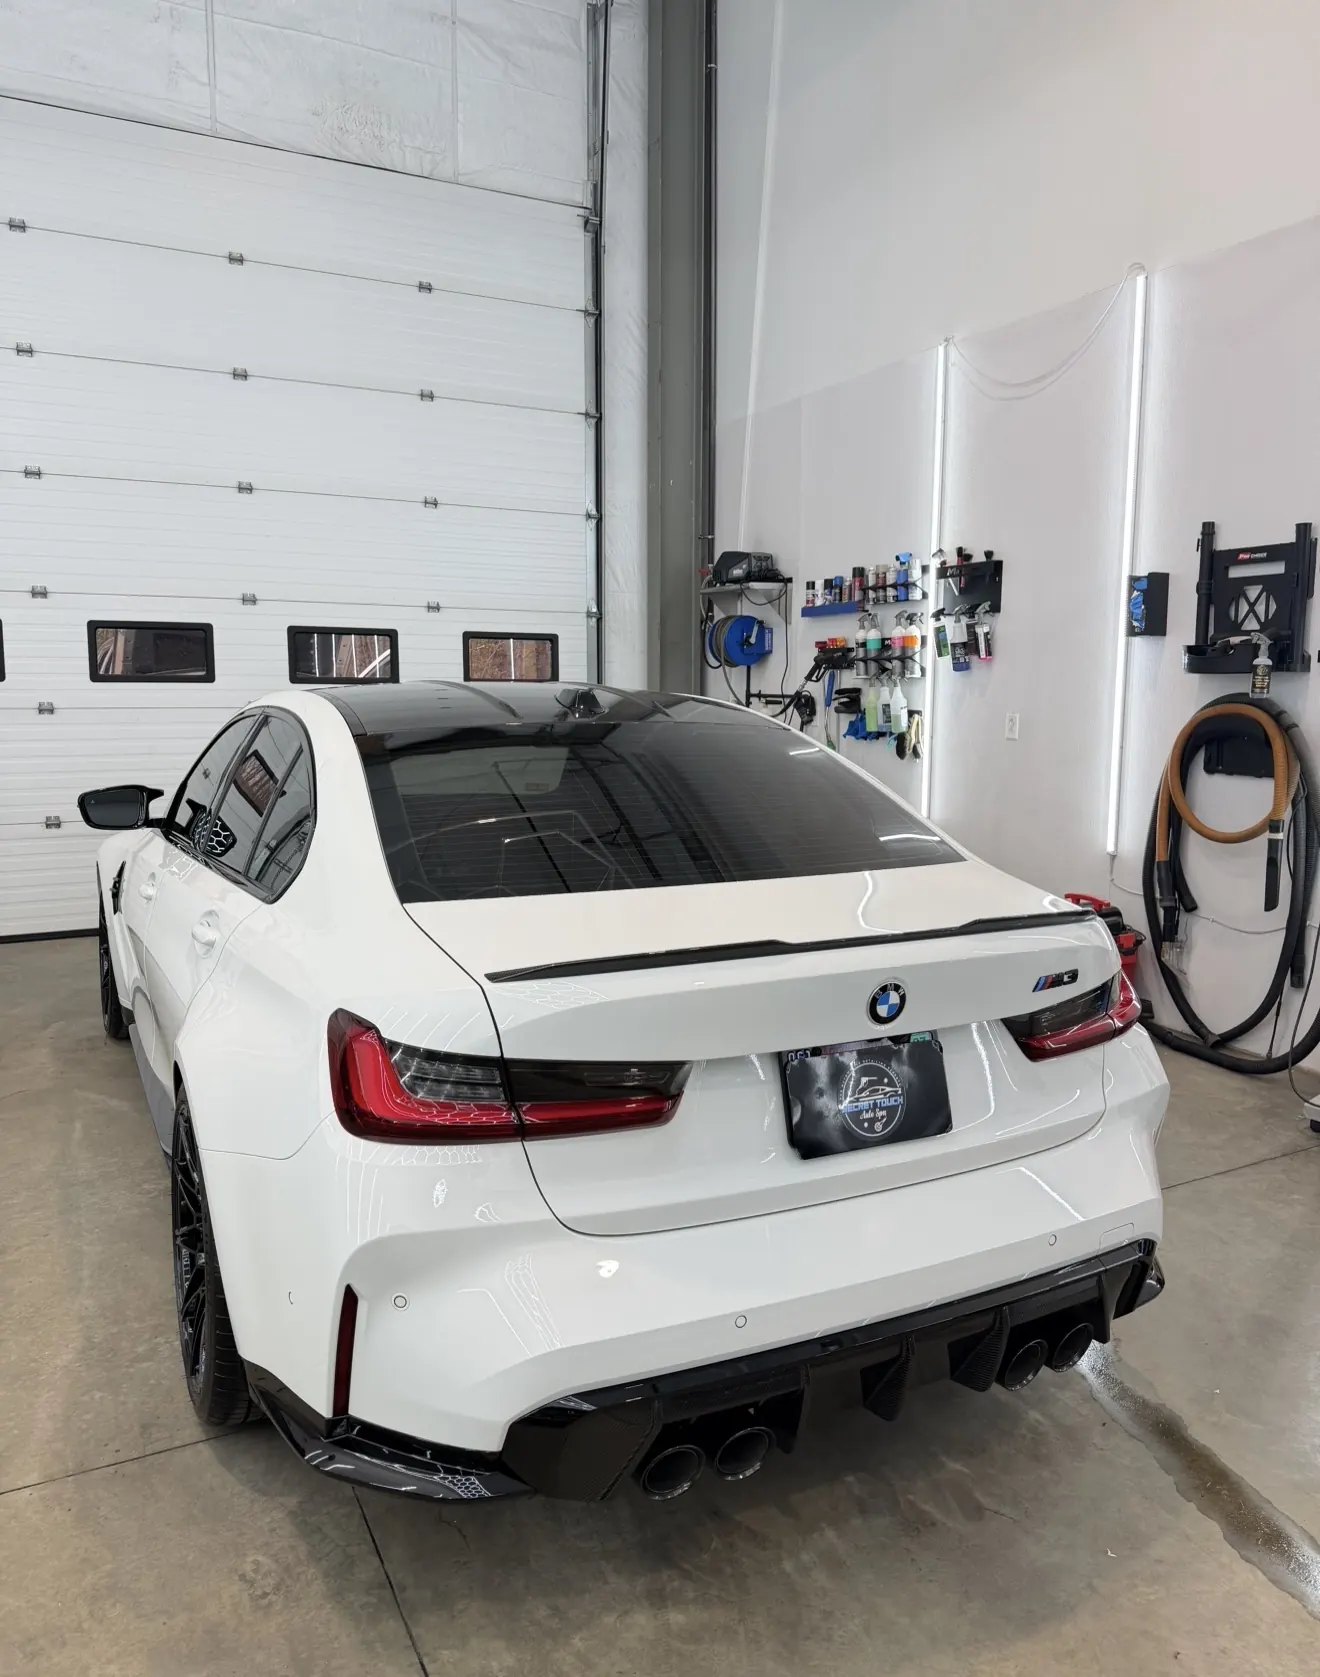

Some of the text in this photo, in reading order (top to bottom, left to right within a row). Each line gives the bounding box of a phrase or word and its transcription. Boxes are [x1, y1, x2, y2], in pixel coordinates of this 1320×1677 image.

[874, 983, 905, 999] BMW
[875, 1096, 903, 1108] TOUCH
[859, 1107, 887, 1120] Auto Spa
